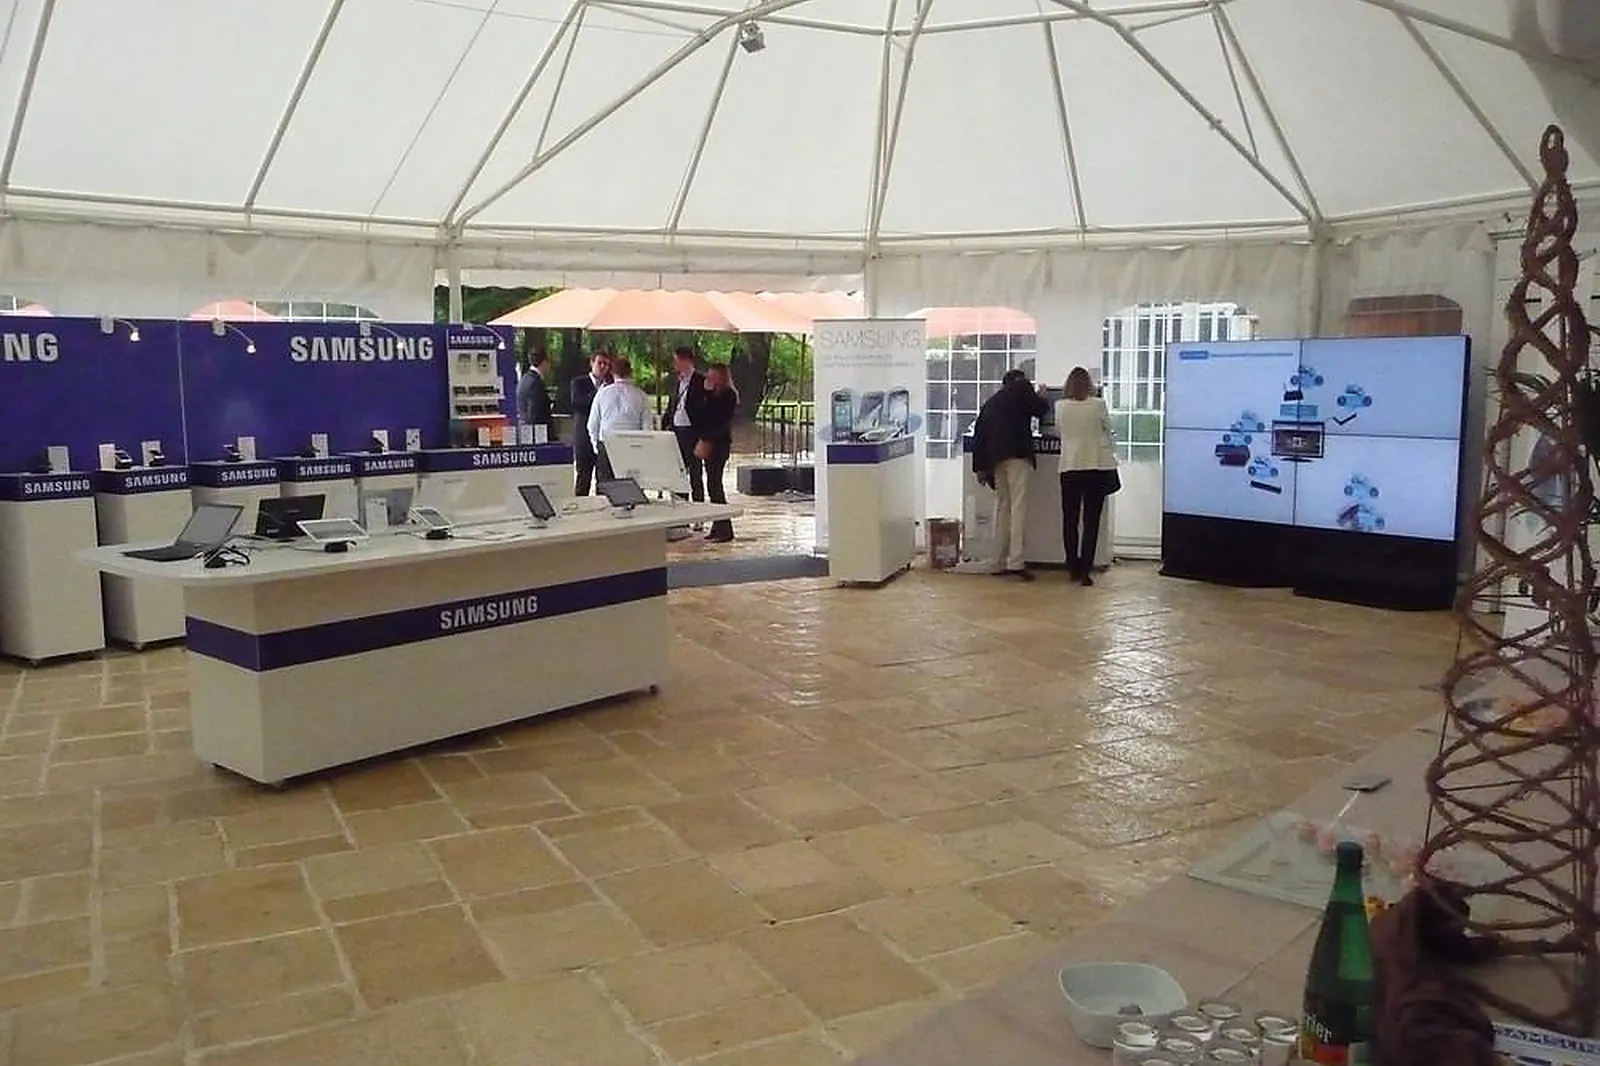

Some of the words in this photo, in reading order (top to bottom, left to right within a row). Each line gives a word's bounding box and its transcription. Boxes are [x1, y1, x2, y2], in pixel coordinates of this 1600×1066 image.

[450, 335, 495, 344] SAMSUNG
[820, 327, 921, 349] SAMSUNG
[290, 335, 434, 362] SAMSUNG
[364, 458, 415, 472] SAMSUNG
[472, 450, 537, 466] SAMSUNG
[220, 467, 277, 482] SAMSUNG
[299, 463, 352, 476] SAMSUNG
[24, 479, 91, 494] SAMSUNG
[125, 472, 187, 488] SAMSUNG
[440, 595, 539, 630] SAMSUNG
